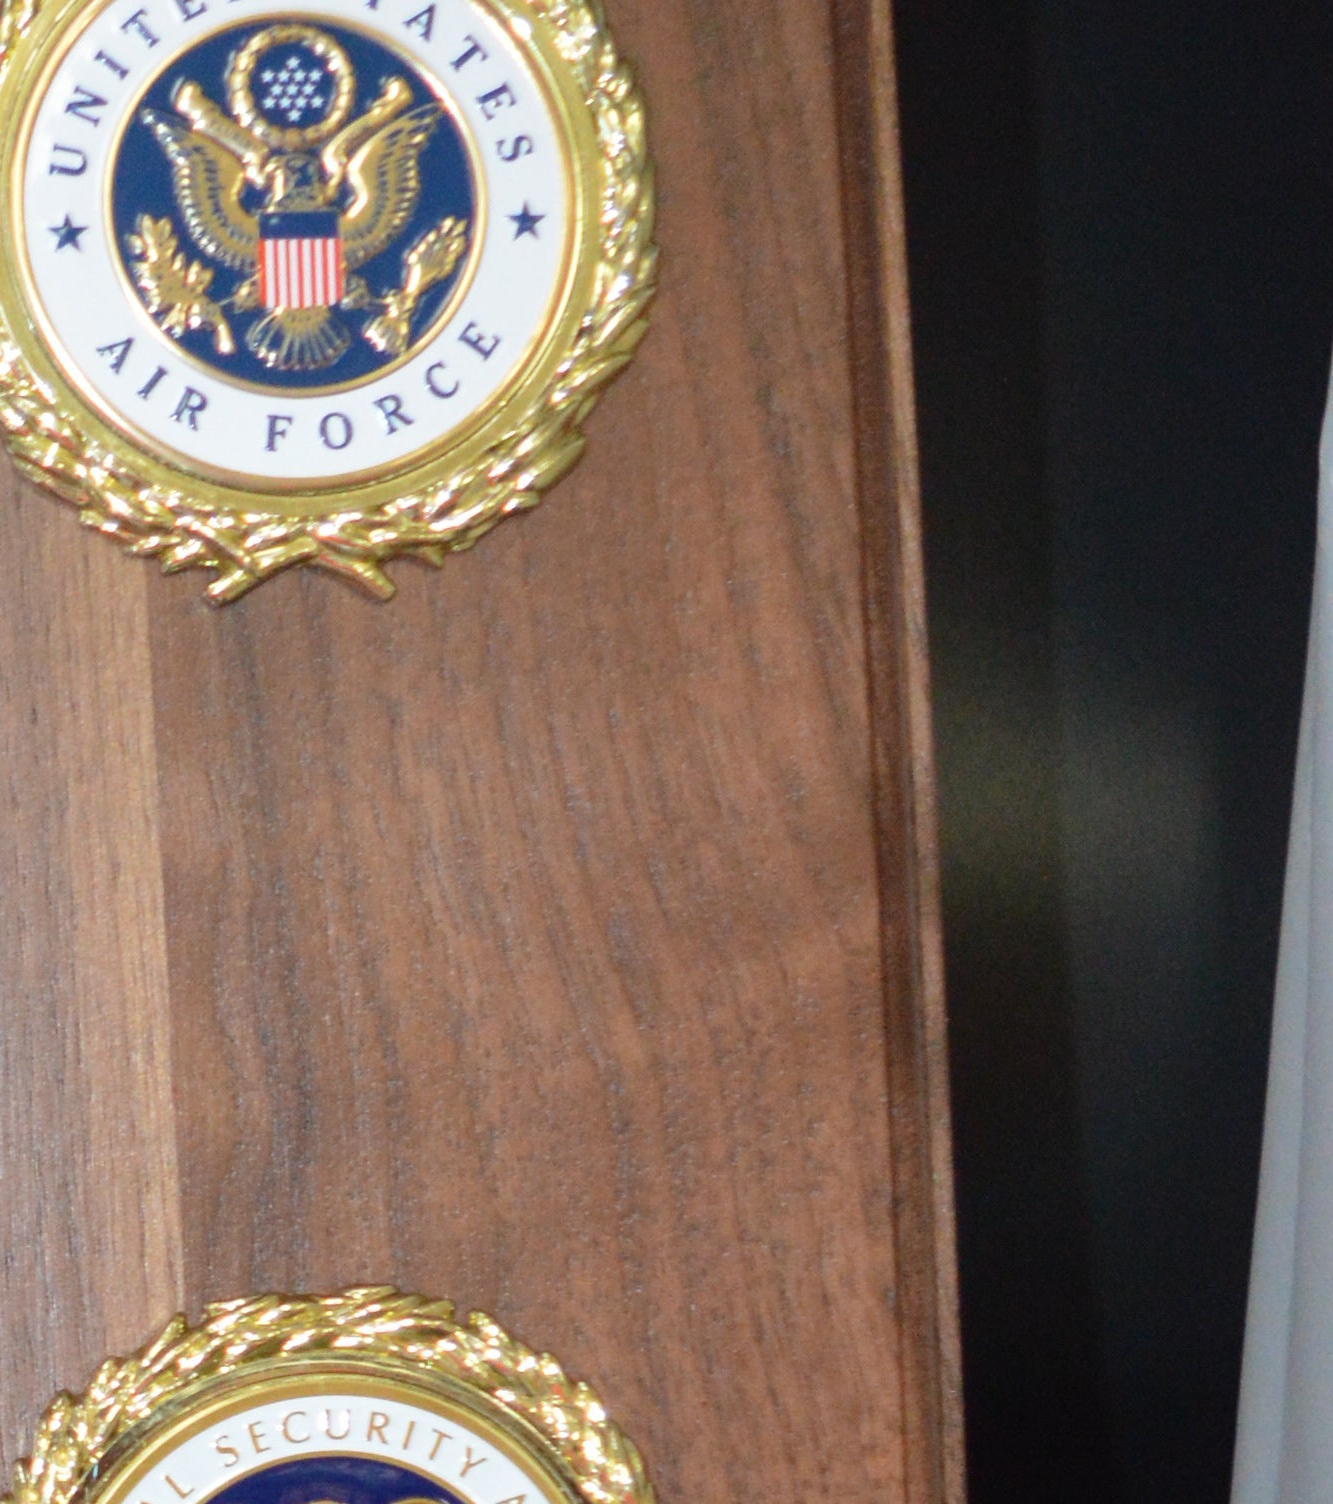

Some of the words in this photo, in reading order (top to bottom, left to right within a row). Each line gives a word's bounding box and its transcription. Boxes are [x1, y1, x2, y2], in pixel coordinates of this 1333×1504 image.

[96, 334, 209, 433] AIR
[265, 323, 500, 451] FORCE
[216, 1410, 488, 1477] SECURITY
